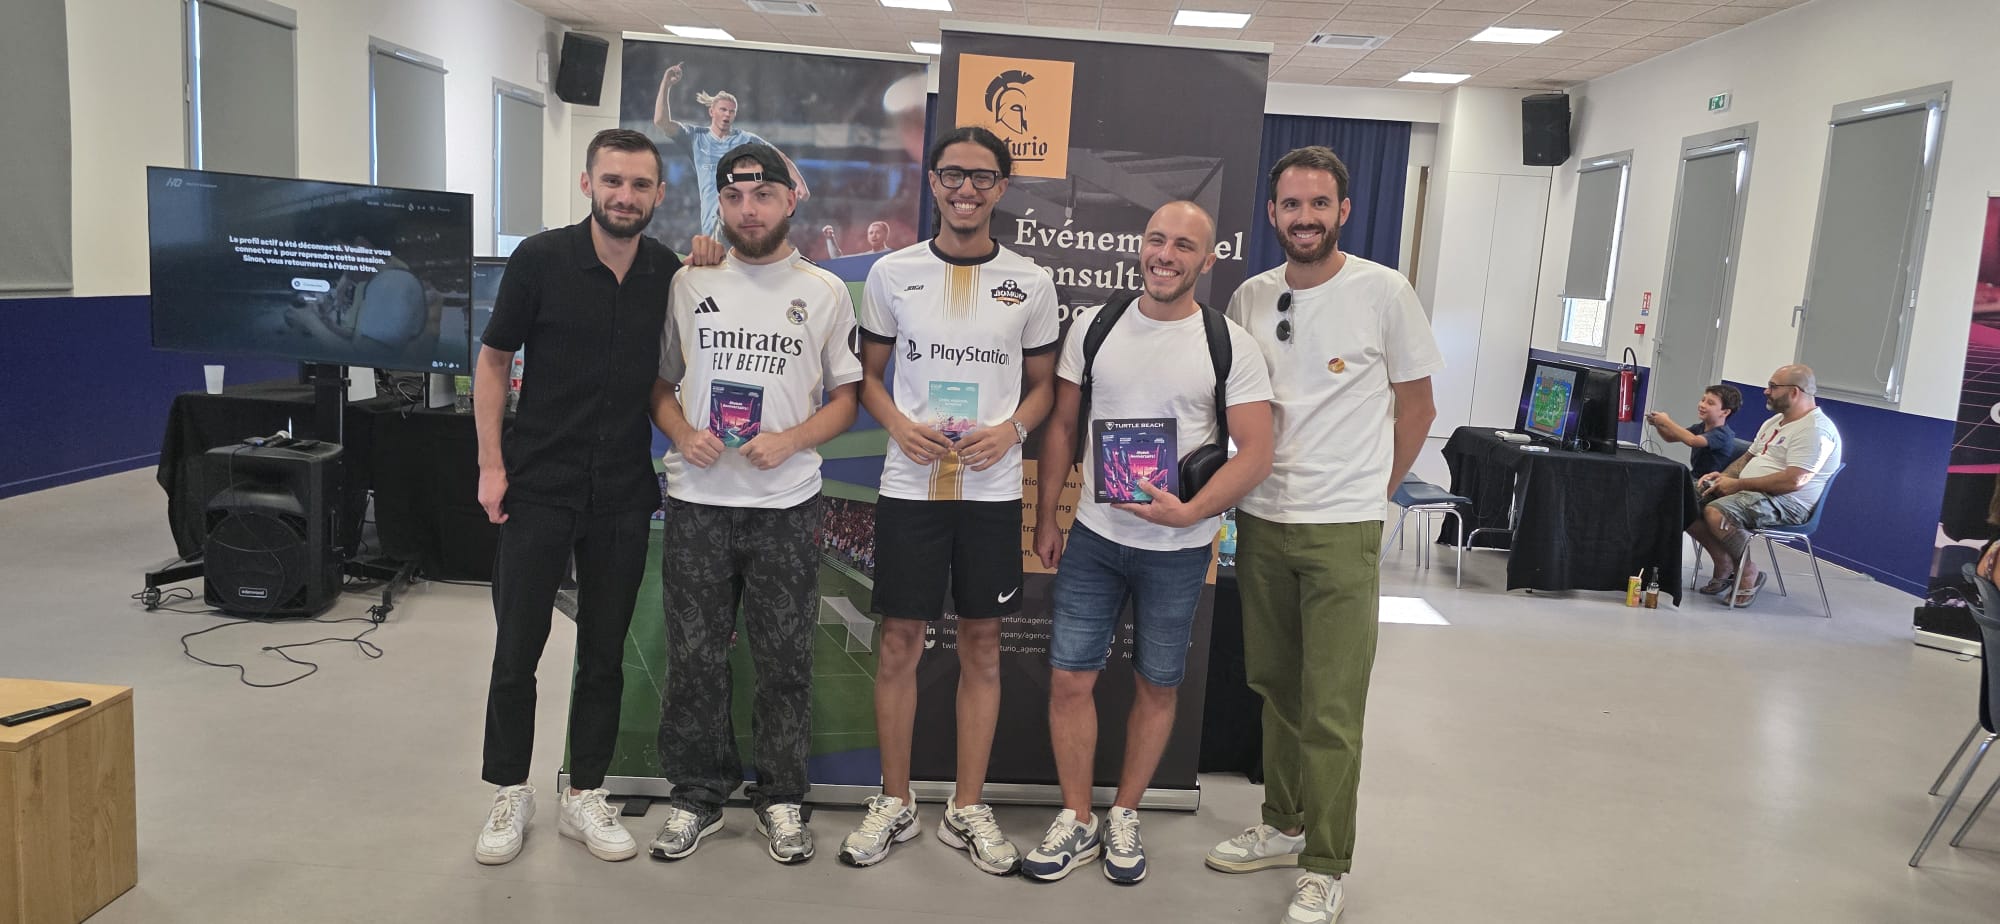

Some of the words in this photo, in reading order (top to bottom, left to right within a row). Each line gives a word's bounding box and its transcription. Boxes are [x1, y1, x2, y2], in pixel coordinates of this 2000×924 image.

[234, 246, 273, 255] connecter
[298, 251, 335, 260] reprendre
[335, 254, 356, 262] cette
[356, 256, 386, 265] session.
[239, 237, 260, 245] profil
[284, 240, 298, 248] été
[298, 241, 343, 252] déconnecté.
[343, 245, 373, 254] Veuillez
[242, 254, 266, 264] Sinon,
[284, 260, 328, 268] retournerez
[359, 264, 378, 273] titre.
[699, 328, 804, 357] Emirates
[712, 352, 733, 371] FLY
[736, 353, 786, 376] BETTER
[930, 343, 1010, 366] PlayStation
